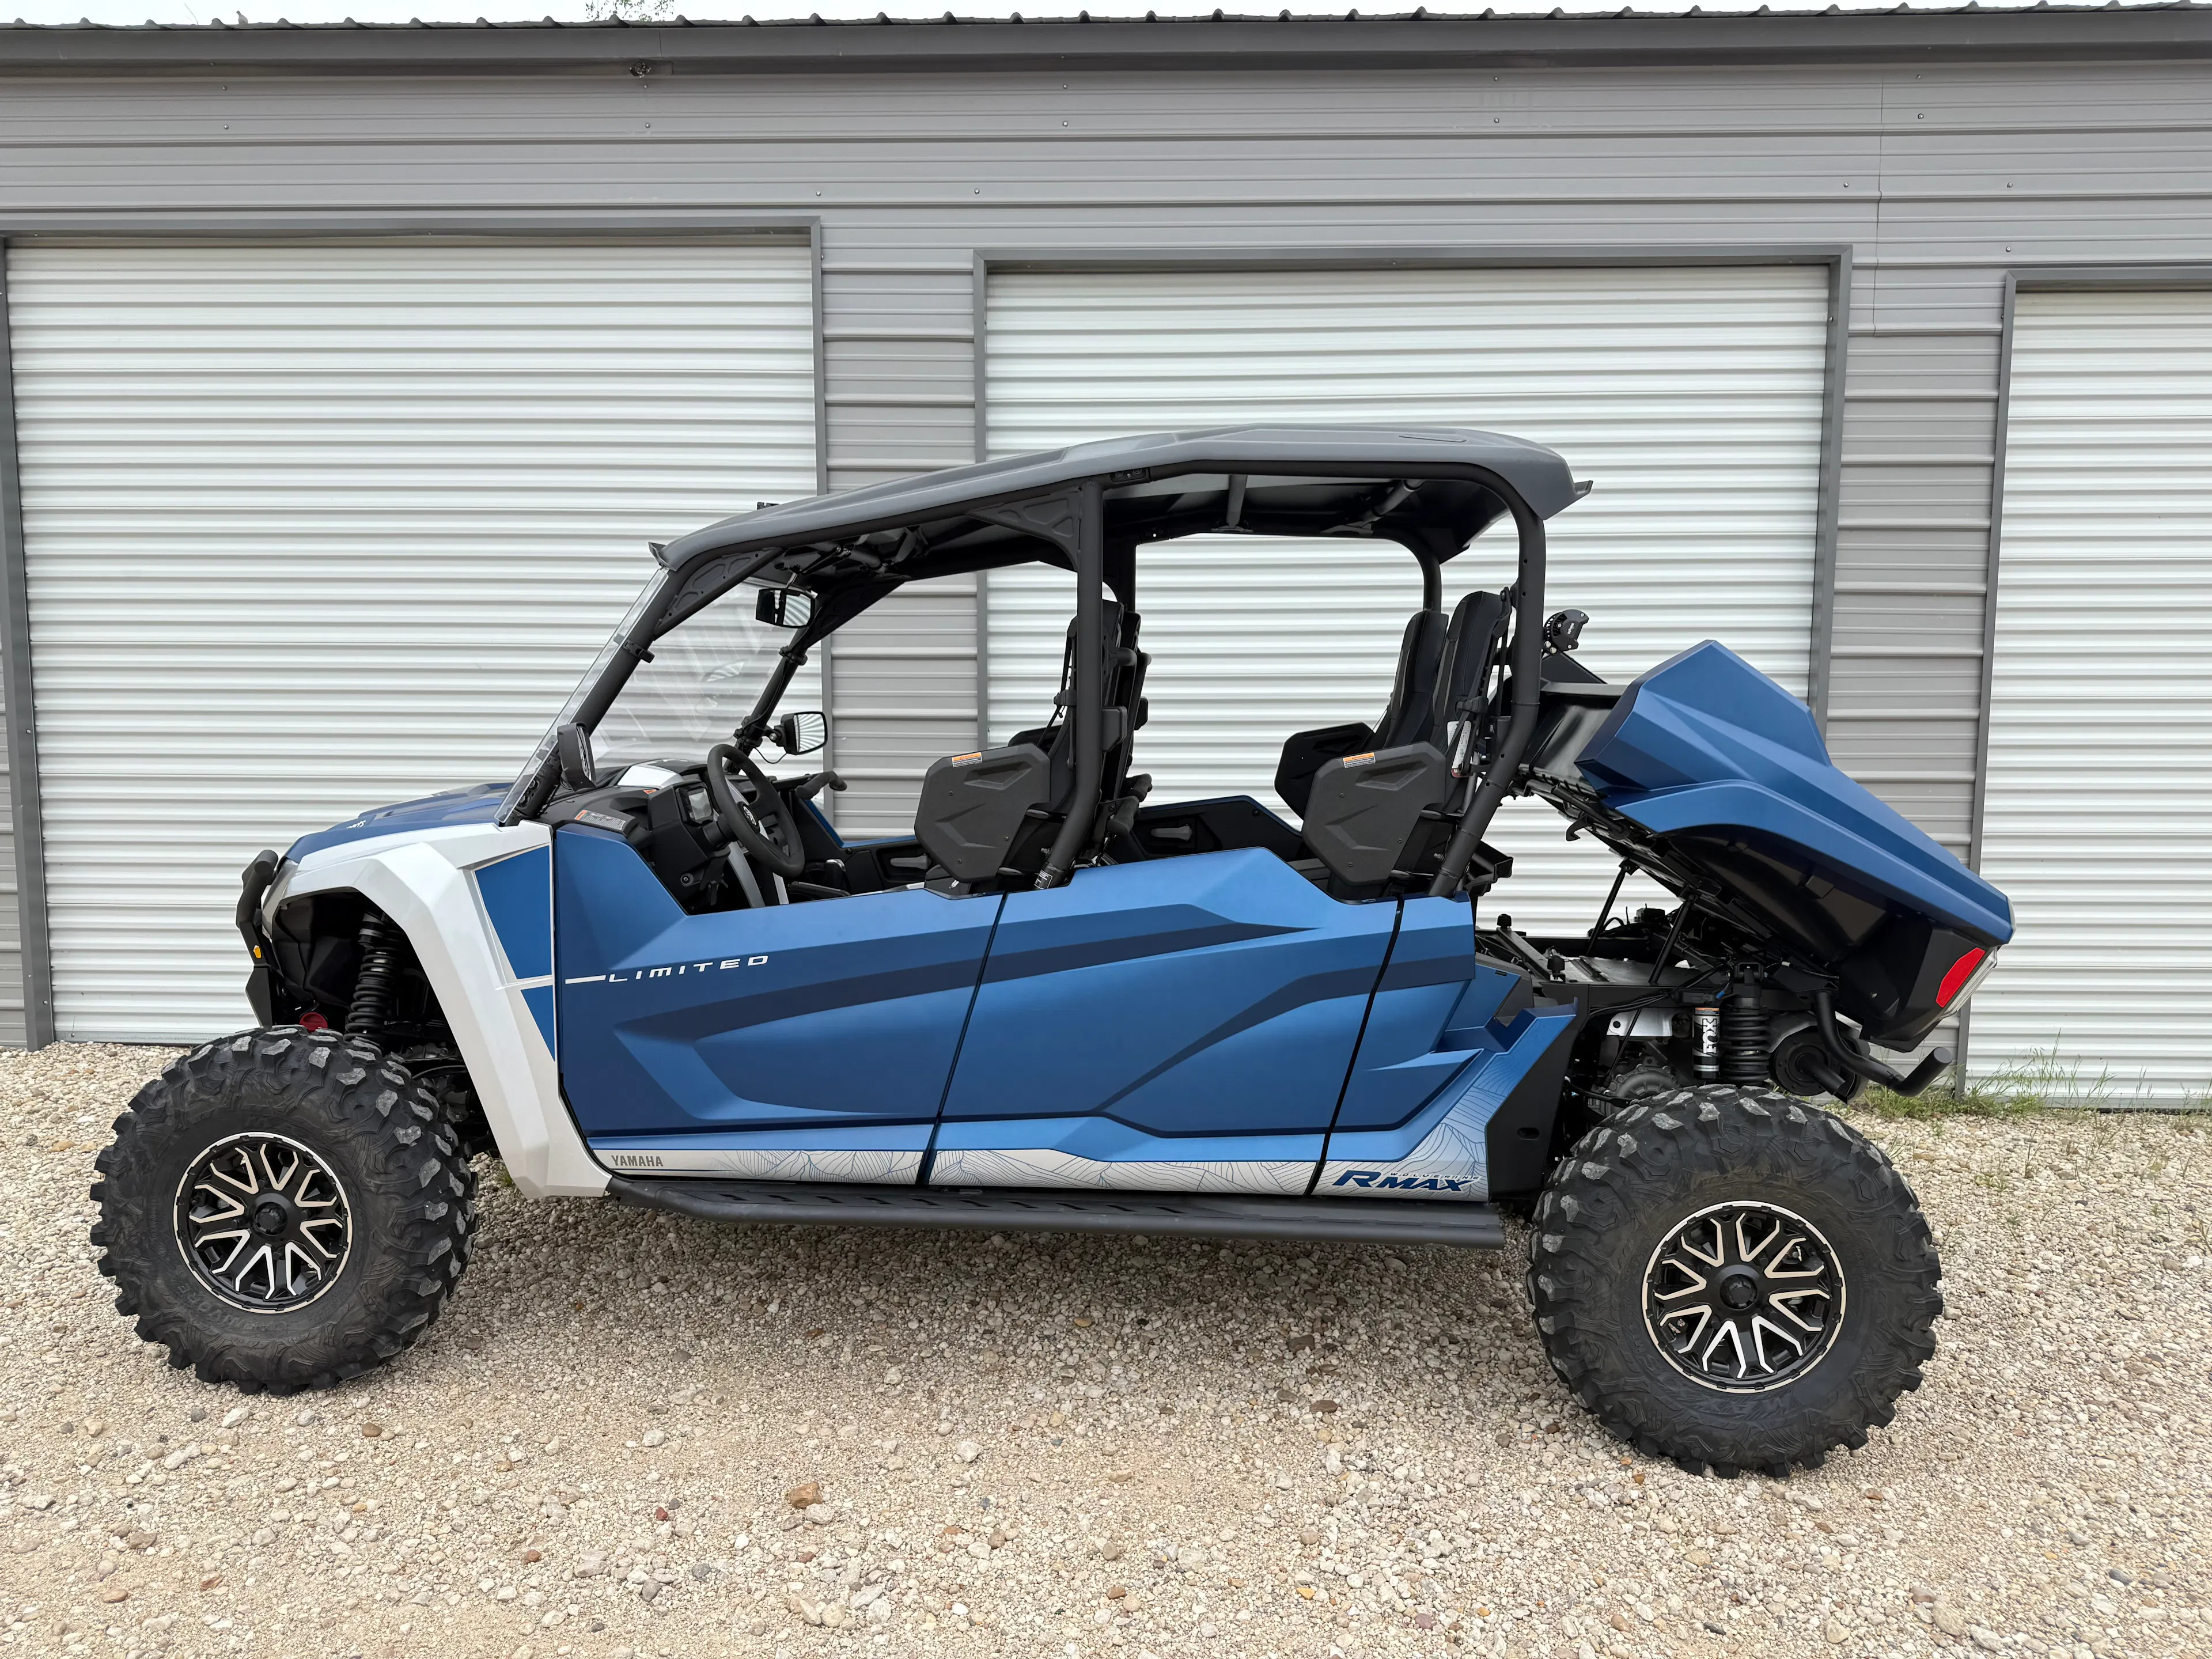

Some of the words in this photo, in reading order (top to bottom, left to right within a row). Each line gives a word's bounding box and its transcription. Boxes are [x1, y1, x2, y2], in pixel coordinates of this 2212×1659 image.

[609, 955, 768, 982] LIMITED
[1702, 1018, 1719, 1054] FOX
[611, 1154, 664, 1168] YAMAHA
[1332, 1170, 1474, 1192] RMAX
